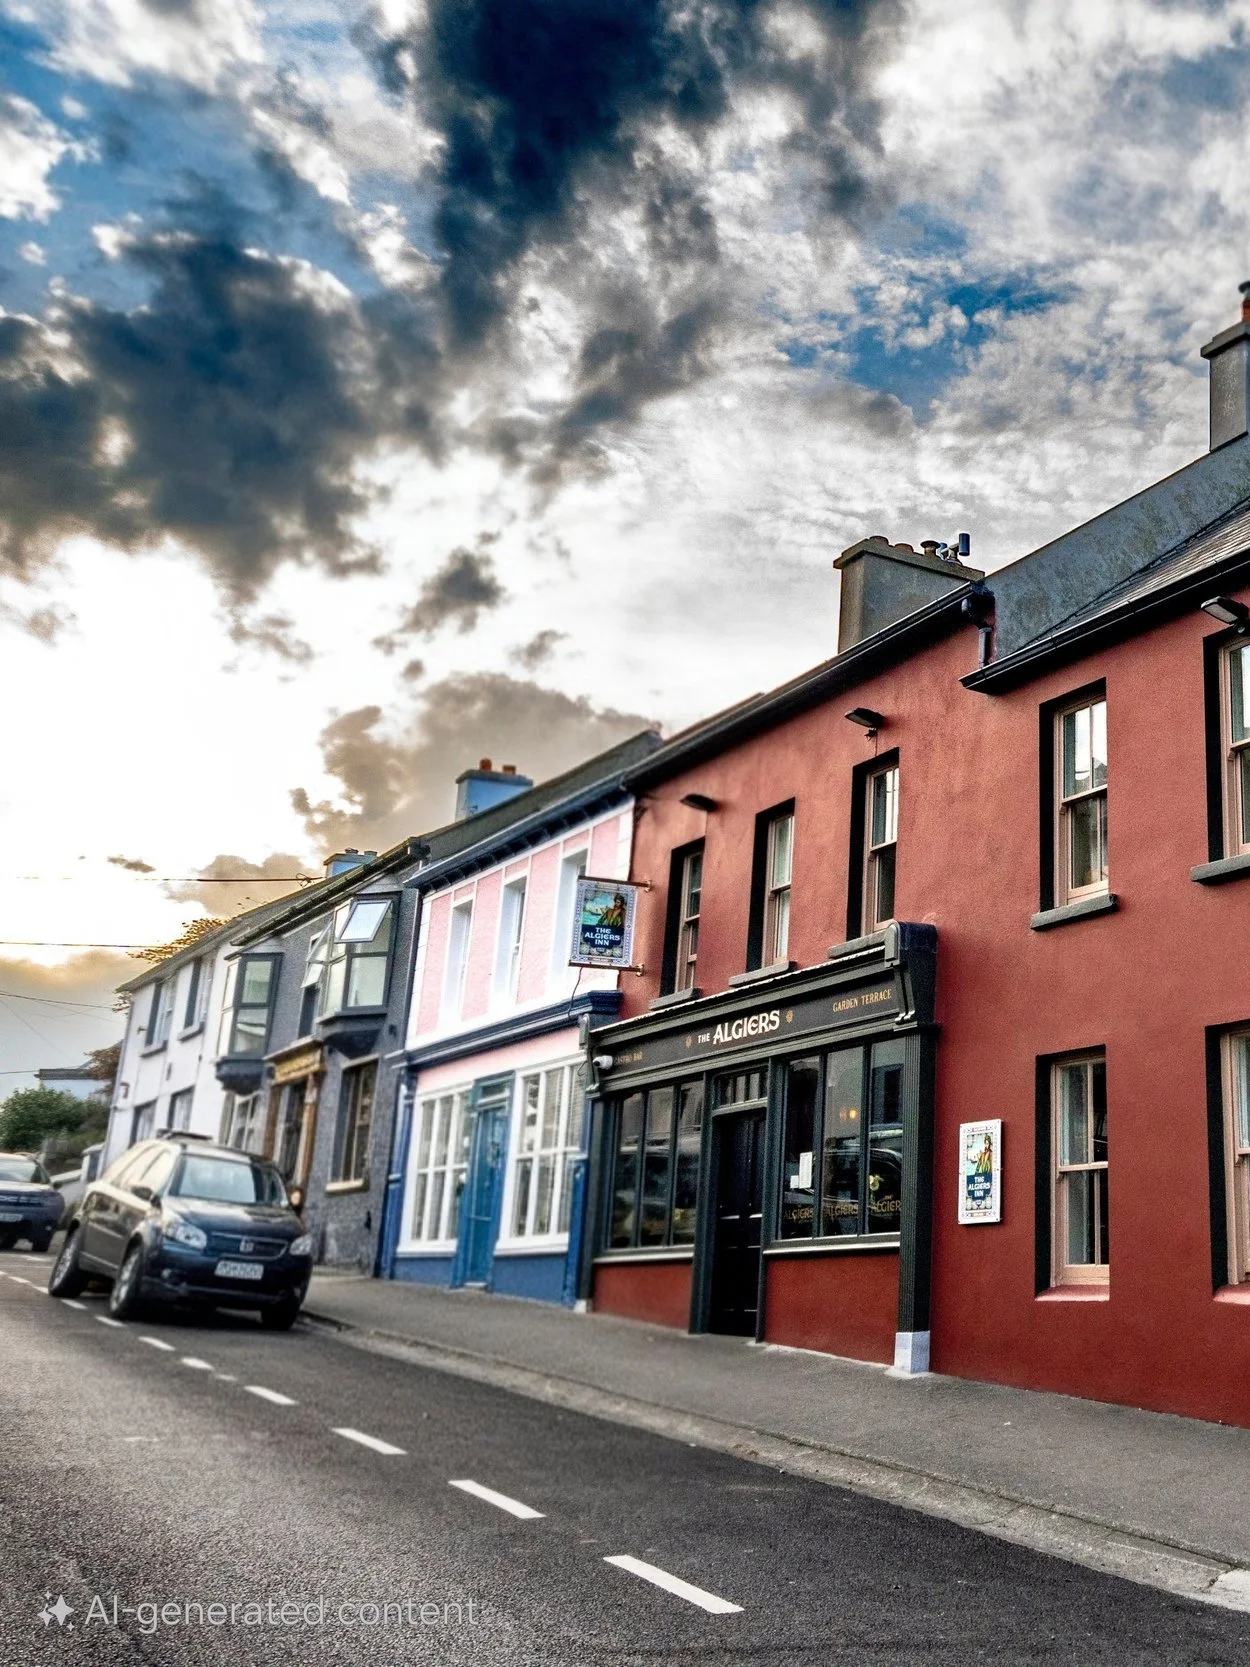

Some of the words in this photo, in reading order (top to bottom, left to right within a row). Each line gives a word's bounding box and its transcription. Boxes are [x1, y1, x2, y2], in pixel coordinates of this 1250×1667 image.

[584, 932, 620, 940] ALGIERS
[832, 997, 858, 1012] GARDEN
[861, 989, 892, 1005] TERRACE
[697, 1033, 711, 1044] THE
[713, 1010, 780, 1044] ALGIERS
[871, 1200, 901, 1212] ALGIER
